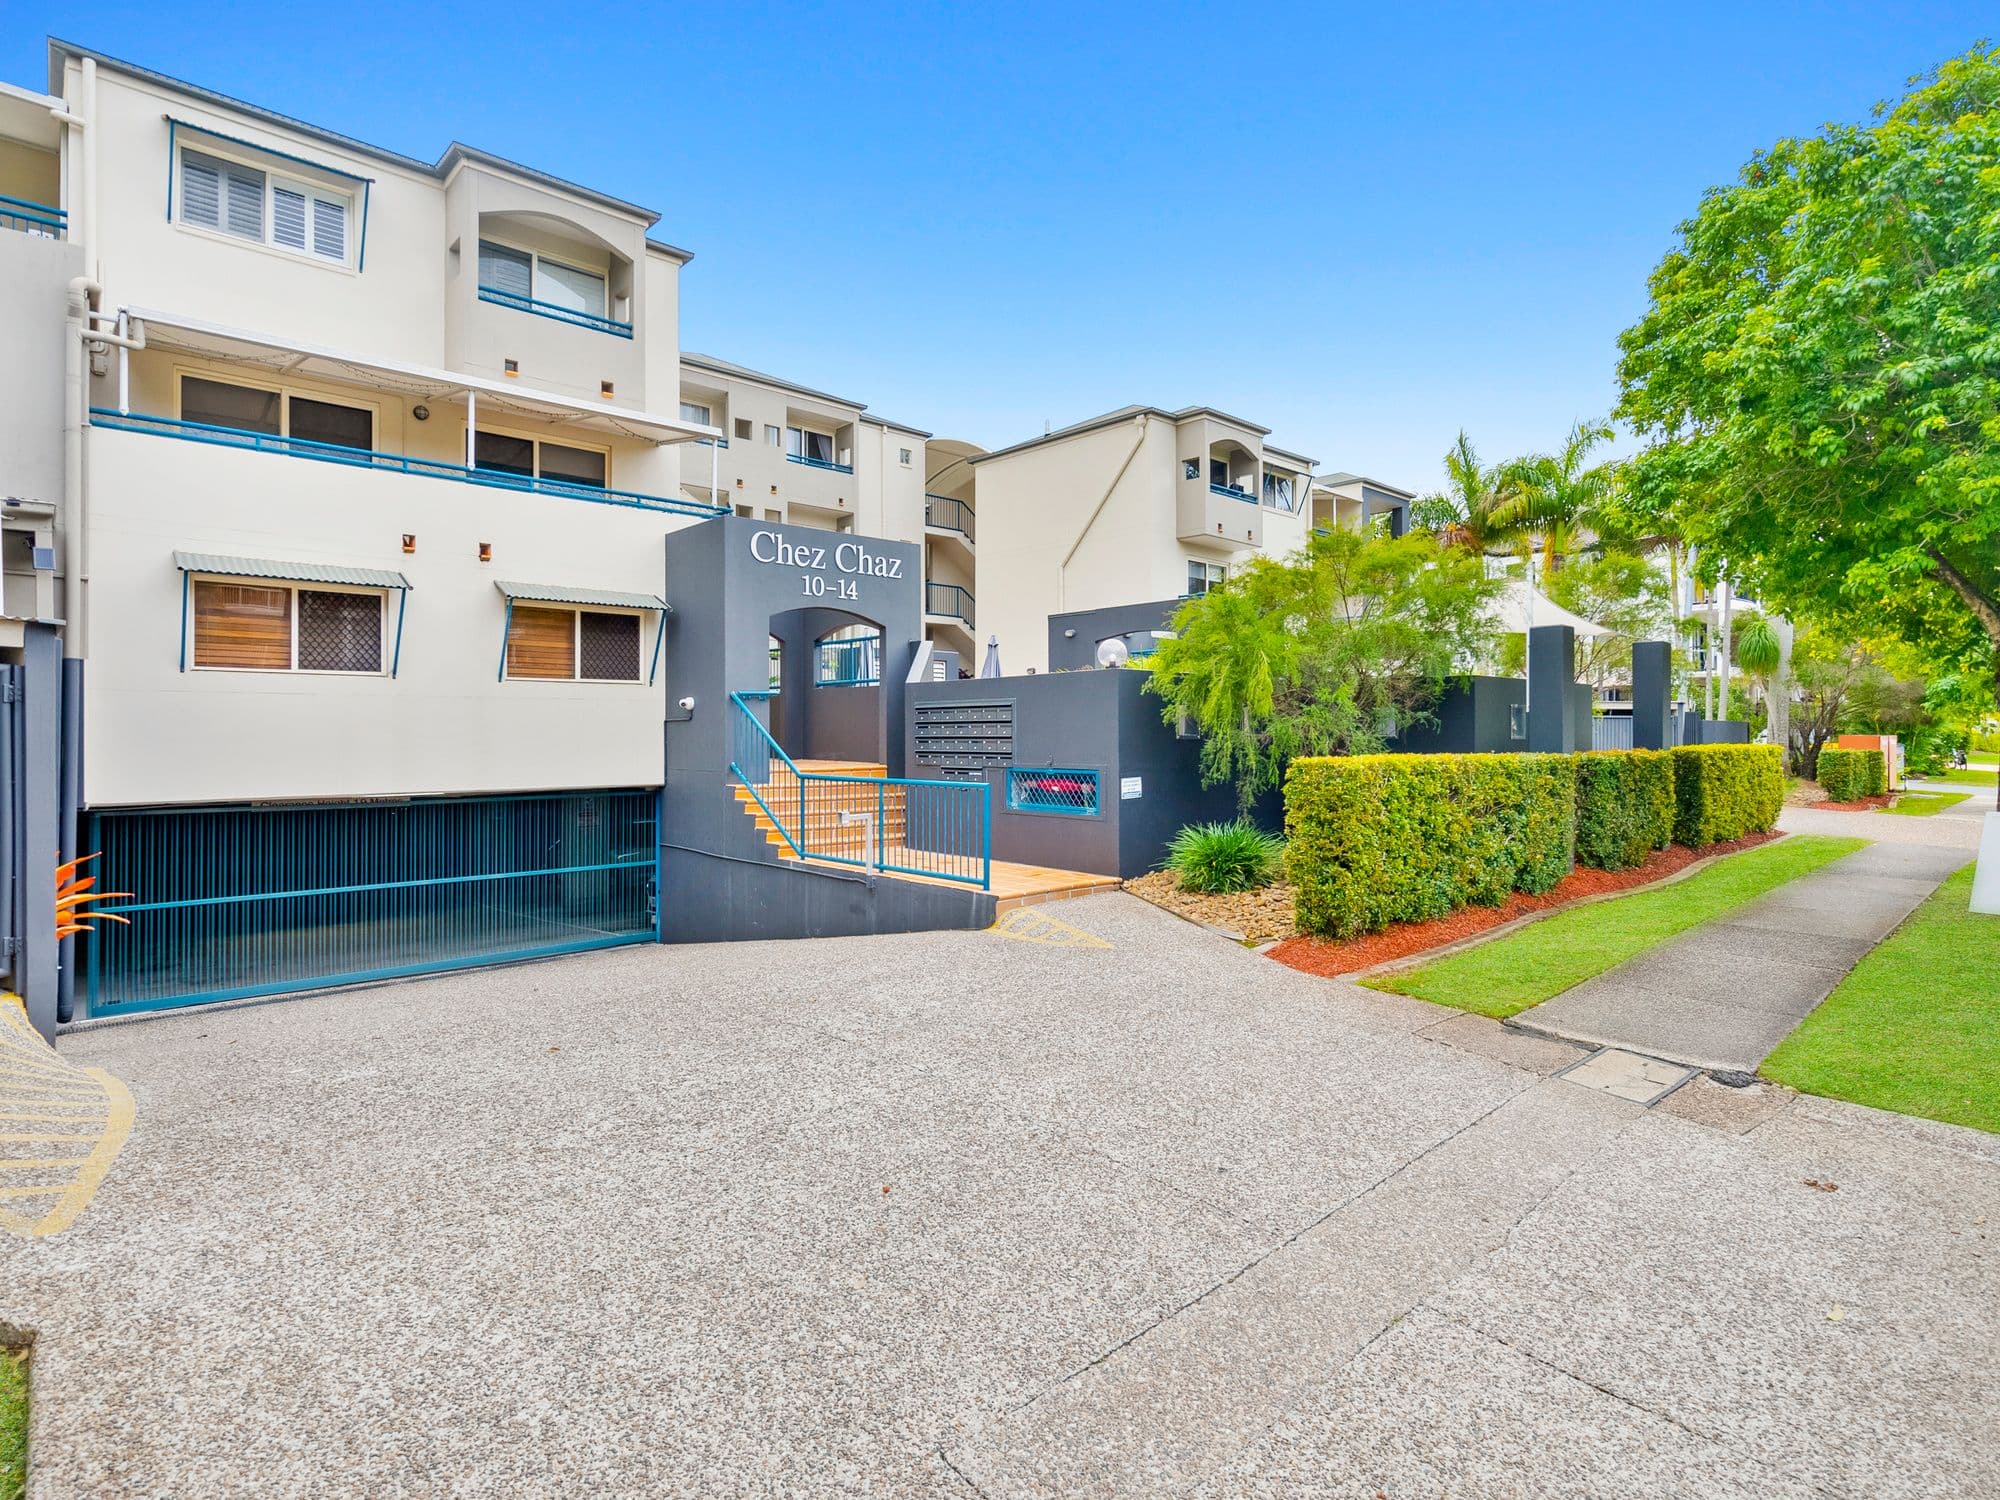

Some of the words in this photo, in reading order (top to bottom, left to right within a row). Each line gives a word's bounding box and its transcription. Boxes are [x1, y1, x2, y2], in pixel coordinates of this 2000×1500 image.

[750, 530, 826, 570] Chez
[835, 543, 903, 579] Chaz
[801, 575, 859, 600] 10-14
